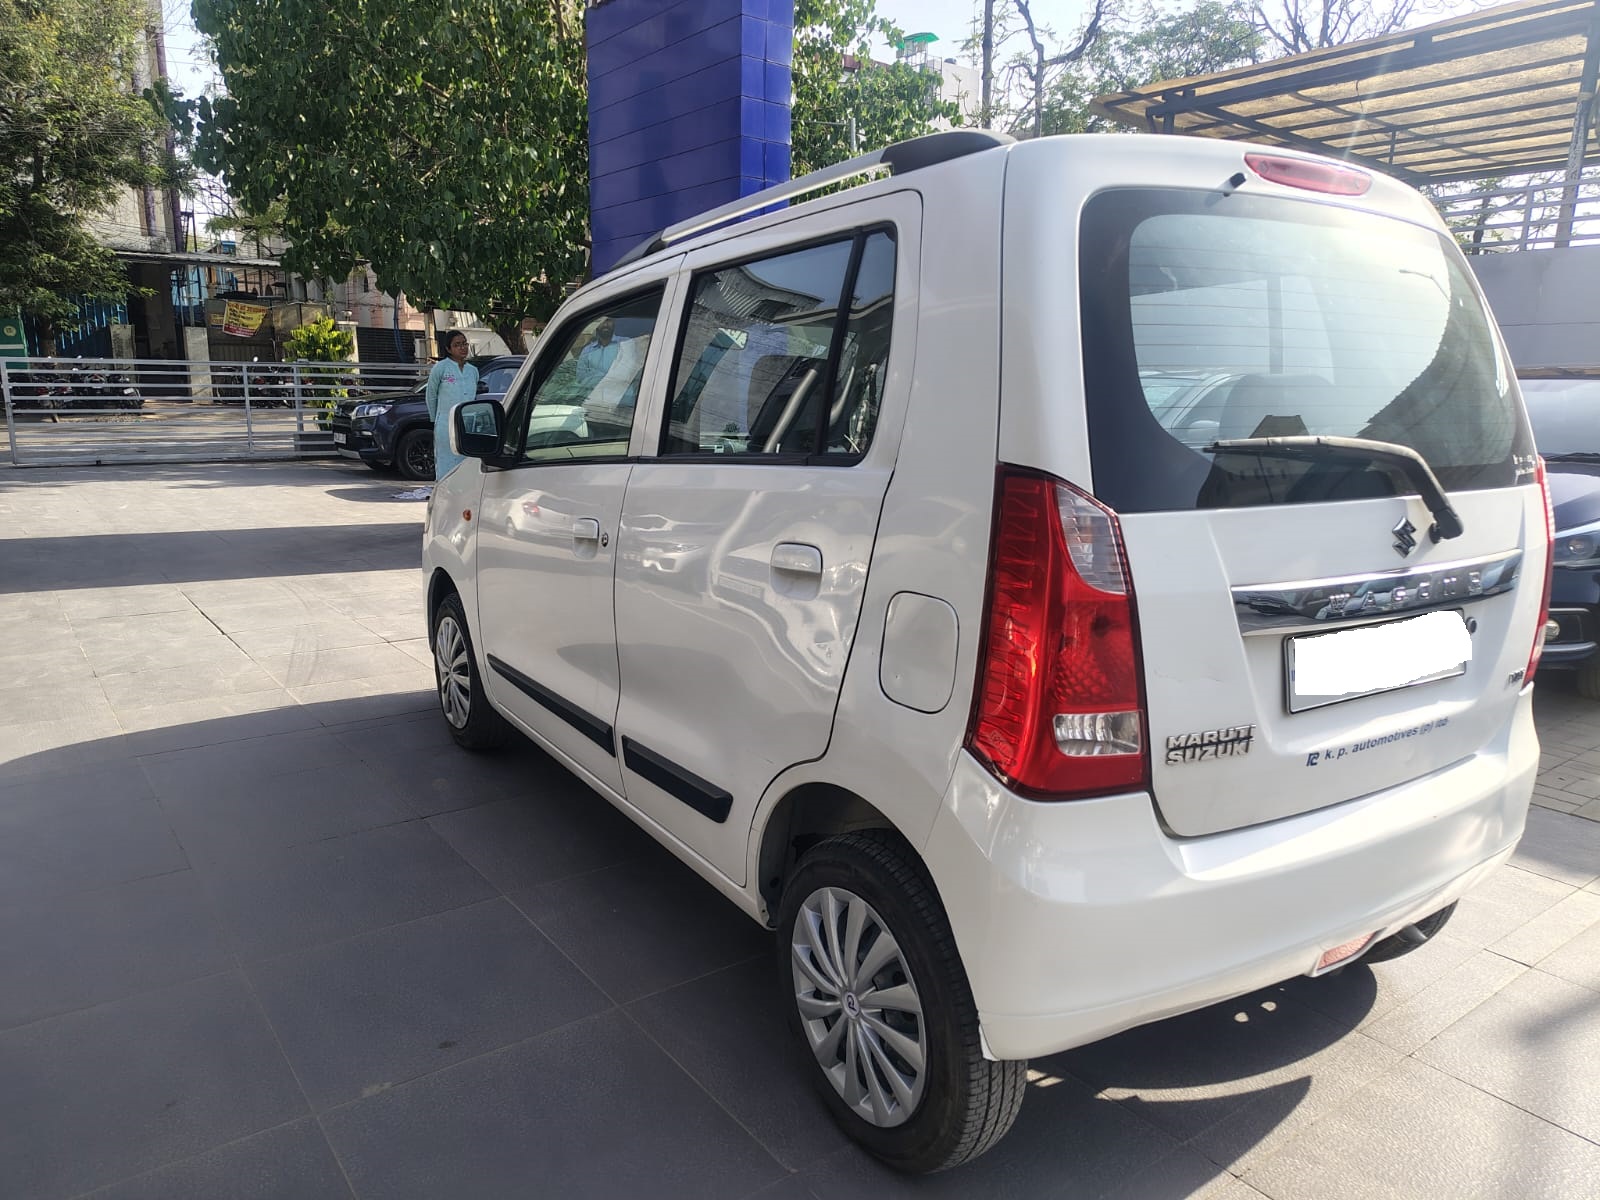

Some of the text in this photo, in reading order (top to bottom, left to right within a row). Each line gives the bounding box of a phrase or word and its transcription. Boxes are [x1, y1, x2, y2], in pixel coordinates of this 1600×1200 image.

[1167, 725, 1256, 750] MARUTI
[1352, 726, 1418, 753] automotives
[1166, 740, 1256, 765] SUZUKI
